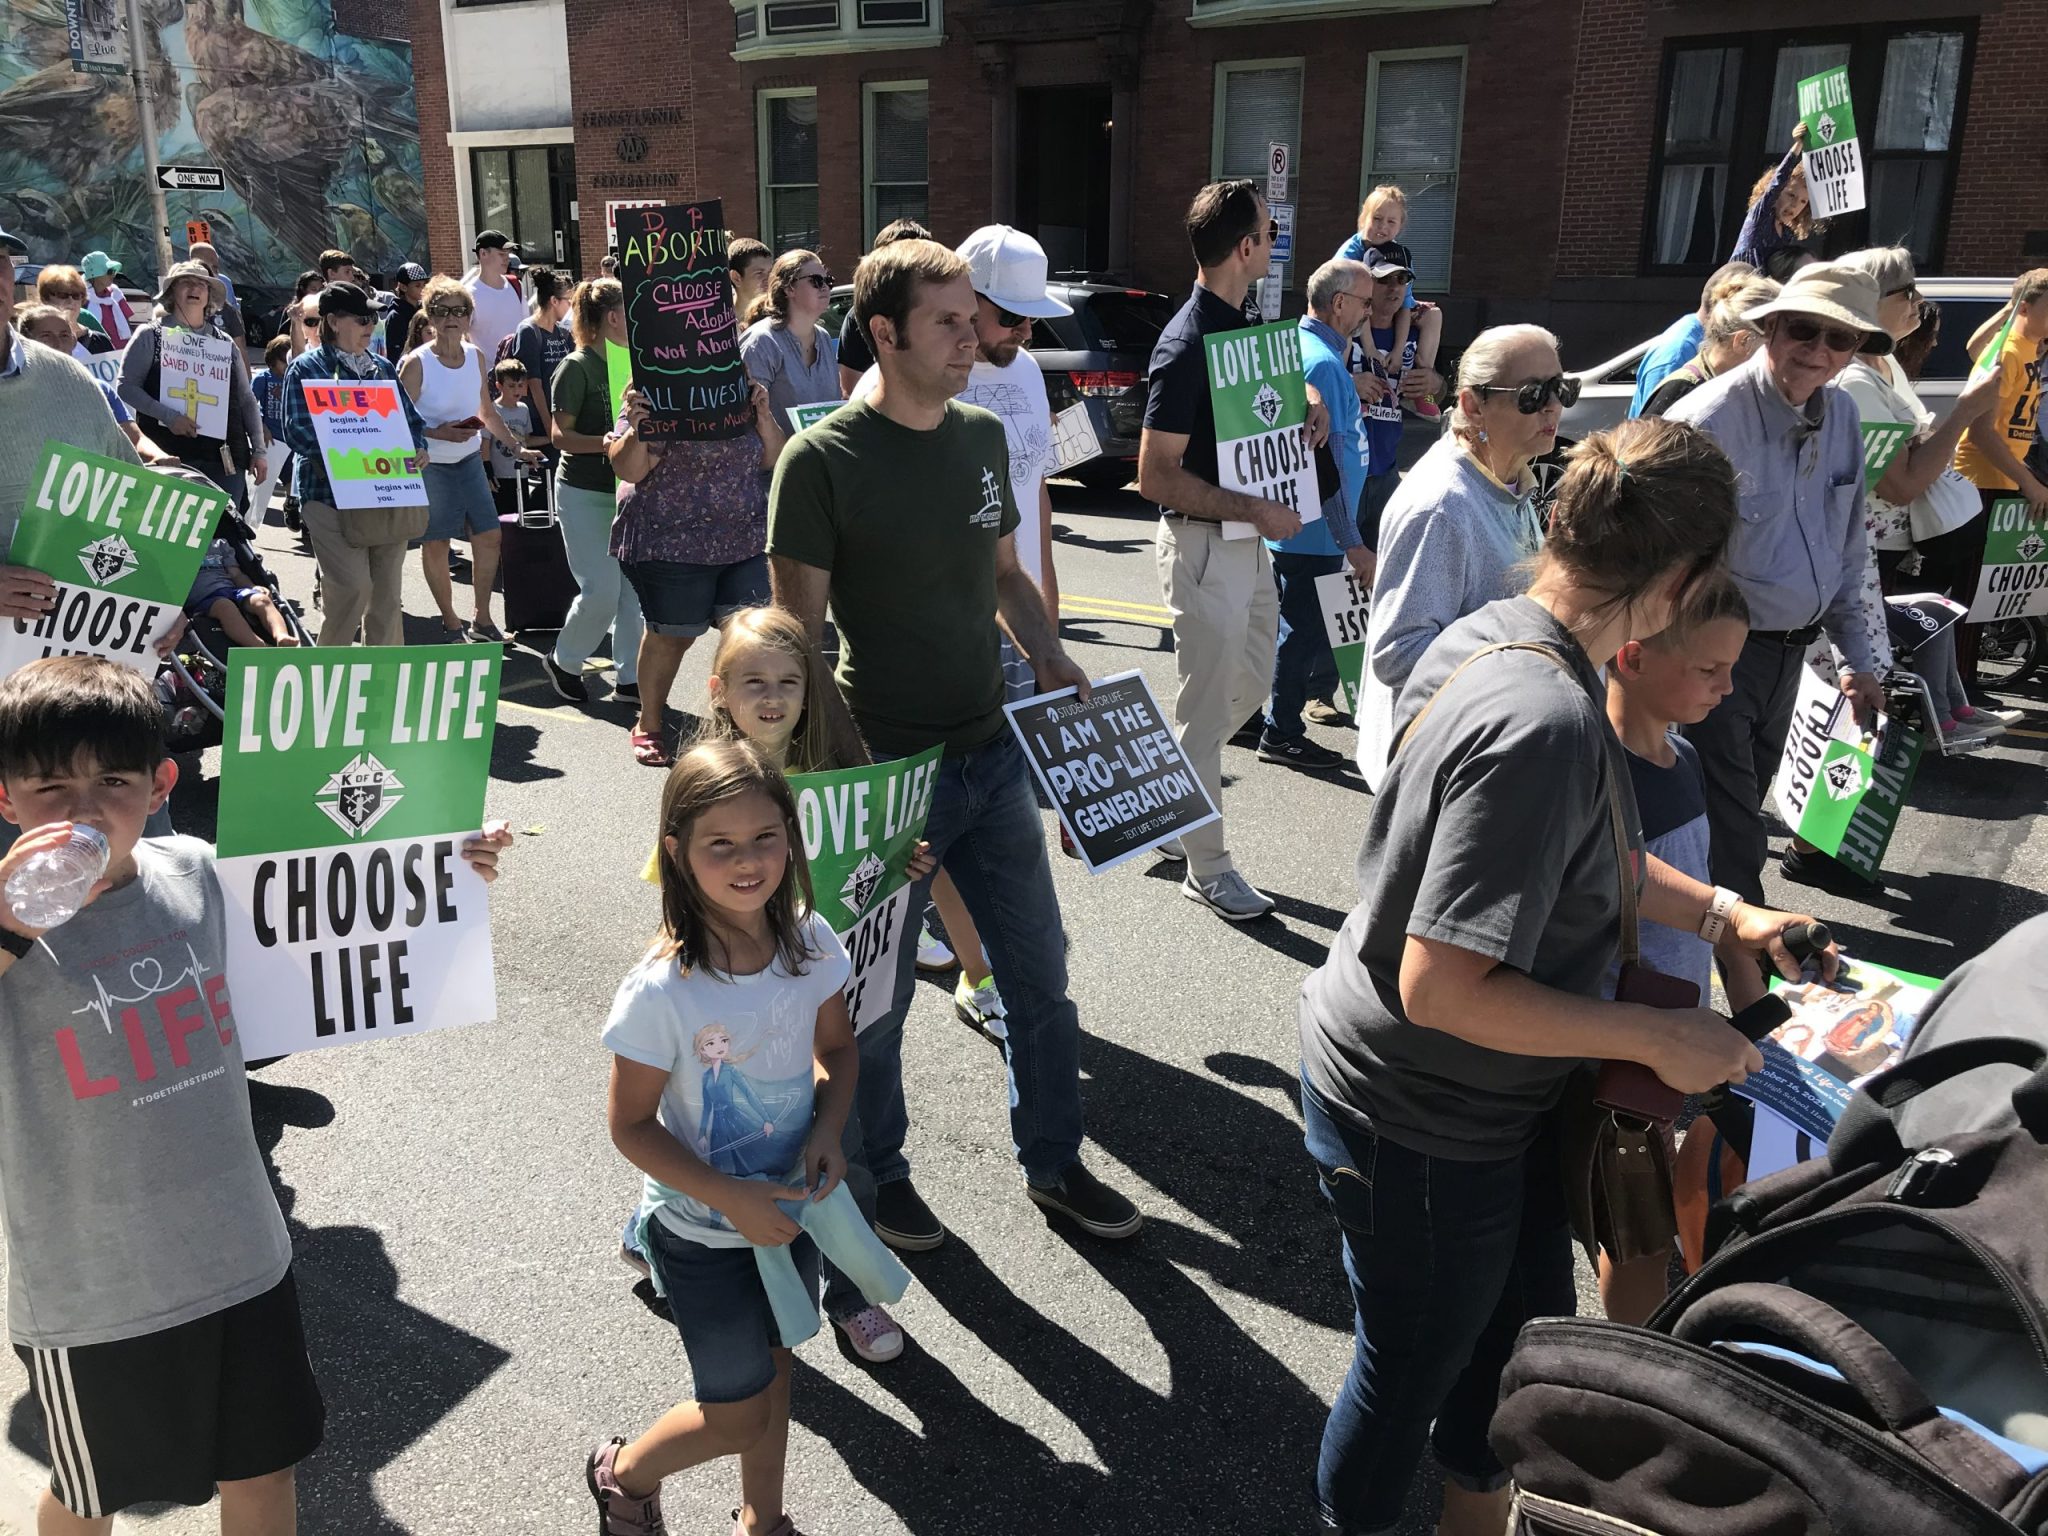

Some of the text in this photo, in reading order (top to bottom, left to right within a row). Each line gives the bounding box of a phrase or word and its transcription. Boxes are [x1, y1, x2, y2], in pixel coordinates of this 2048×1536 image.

[1800, 71, 1849, 117] LOVE LIFE
[1810, 143, 1855, 182] CHOOSE
[178, 174, 216, 184] ONE WAY
[1826, 179, 1848, 212] LIFE
[653, 281, 721, 304] CHOOSE
[182, 334, 206, 348] ONE
[654, 344, 688, 360] Not
[162, 353, 228, 382] SAVED US ALL!
[1211, 328, 1301, 389] LOVE LIFE
[312, 390, 369, 408] LIFE
[641, 386, 680, 412] ALL
[690, 383, 736, 412] LIVES
[329, 416, 358, 424] begins
[332, 427, 382, 435] conception.
[362, 457, 419, 475] LOVE
[1234, 427, 1308, 486] CHOOSE
[36, 453, 217, 549] LOVE LIFE
[374, 484, 402, 492] begins
[98, 544, 105, 553] K
[1988, 564, 2048, 593] CHOOS
[1994, 592, 2032, 618] LIFE
[239, 659, 490, 753] LOVE LIFE
[1057, 690, 1125, 719] STUDENTS FOR LIFE
[1036, 702, 1153, 759] I AM THE
[1785, 709, 1805, 768] LIFE
[341, 771, 384, 785] K OF C
[1046, 729, 1181, 804] PRO-LIFE
[884, 757, 938, 841] LIFE
[1074, 769, 1195, 838] GENERATION
[1123, 811, 1177, 840] TEXT LIFE TO 53445
[1840, 802, 1889, 872] LIFE
[855, 864, 879, 882] K OF C
[253, 840, 458, 947] CHOOSE
[311, 939, 414, 1037] LIFE
[55, 973, 232, 1101] LIFE
[132, 1066, 226, 1108] #TOGETHERSTRONG
[1763, 1079, 1782, 1095] High
[1782, 1091, 1809, 1113] School,
[1787, 1081, 1800, 1094] 16,
[1801, 1091, 1827, 1110] 2021
